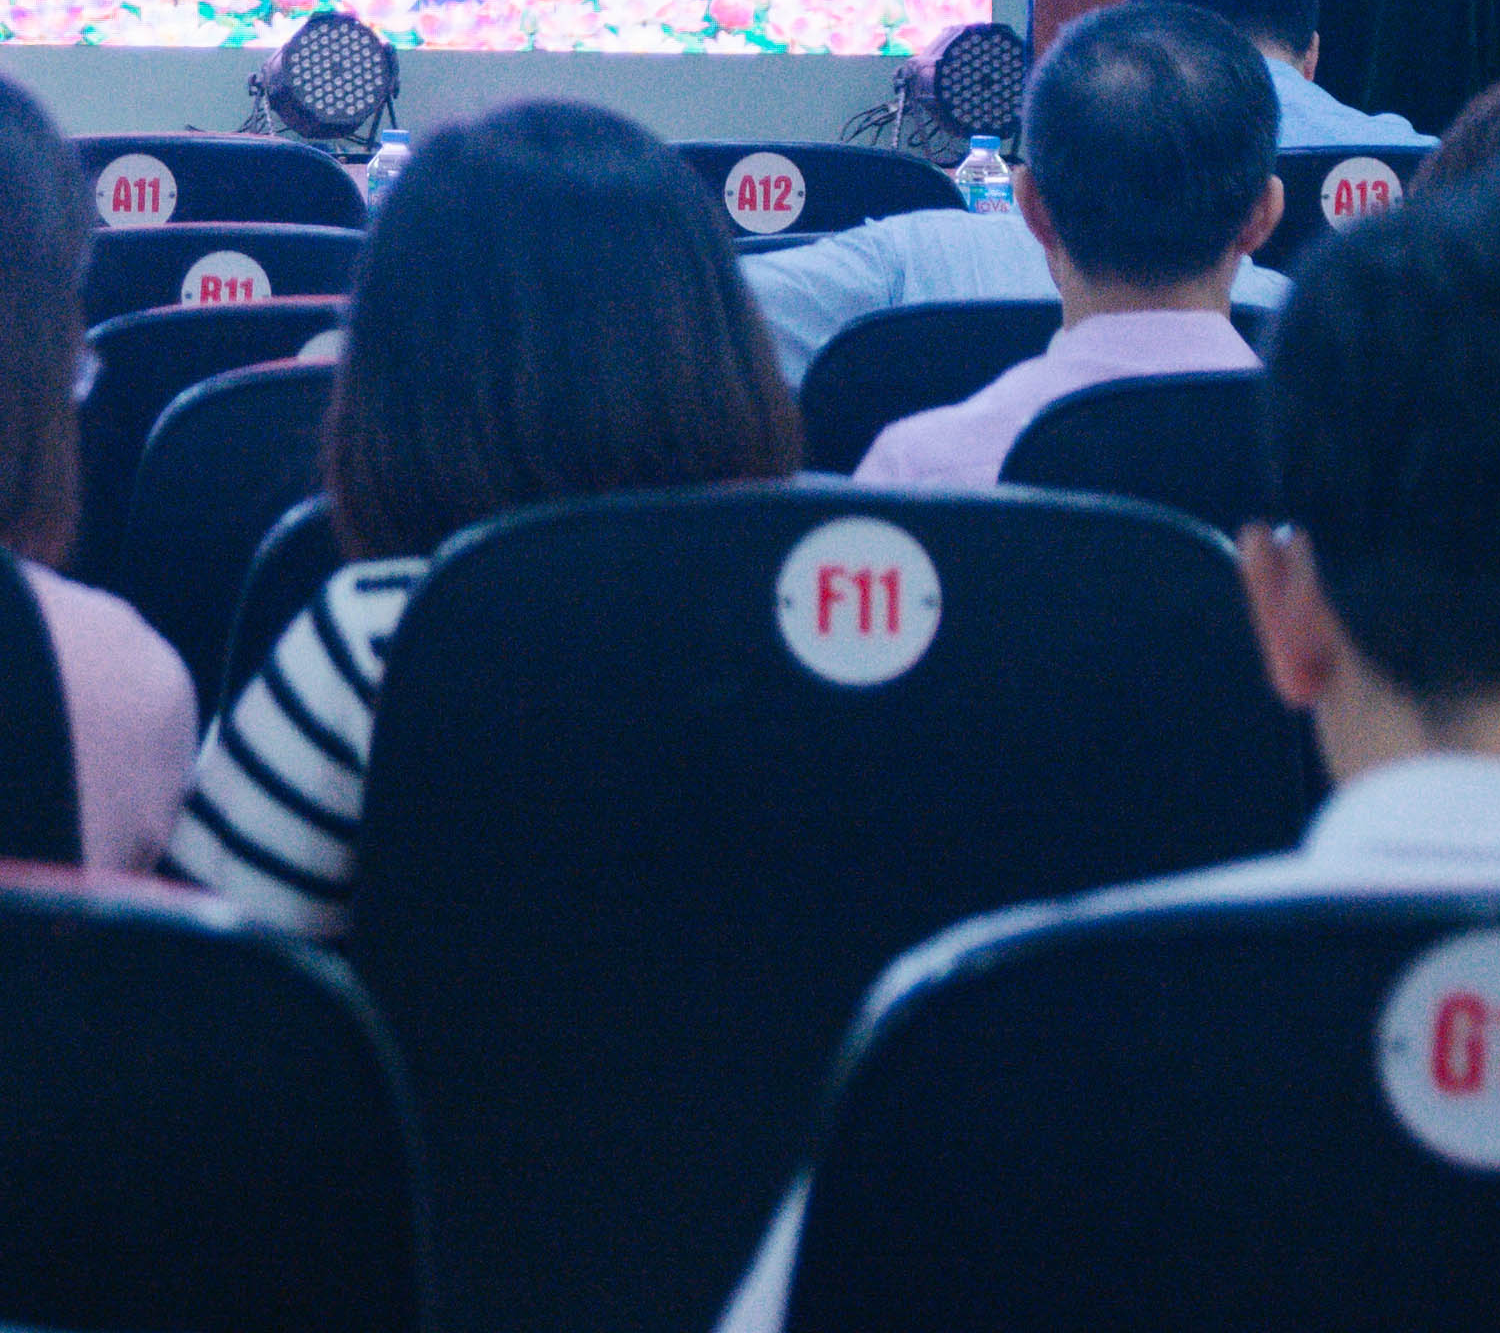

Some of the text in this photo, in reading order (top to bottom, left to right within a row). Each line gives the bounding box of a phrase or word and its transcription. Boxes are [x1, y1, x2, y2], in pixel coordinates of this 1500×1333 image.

[112, 176, 160, 213] A11
[737, 174, 793, 213] A12
[1334, 179, 1389, 217] A13
[815, 564, 901, 637] F11
